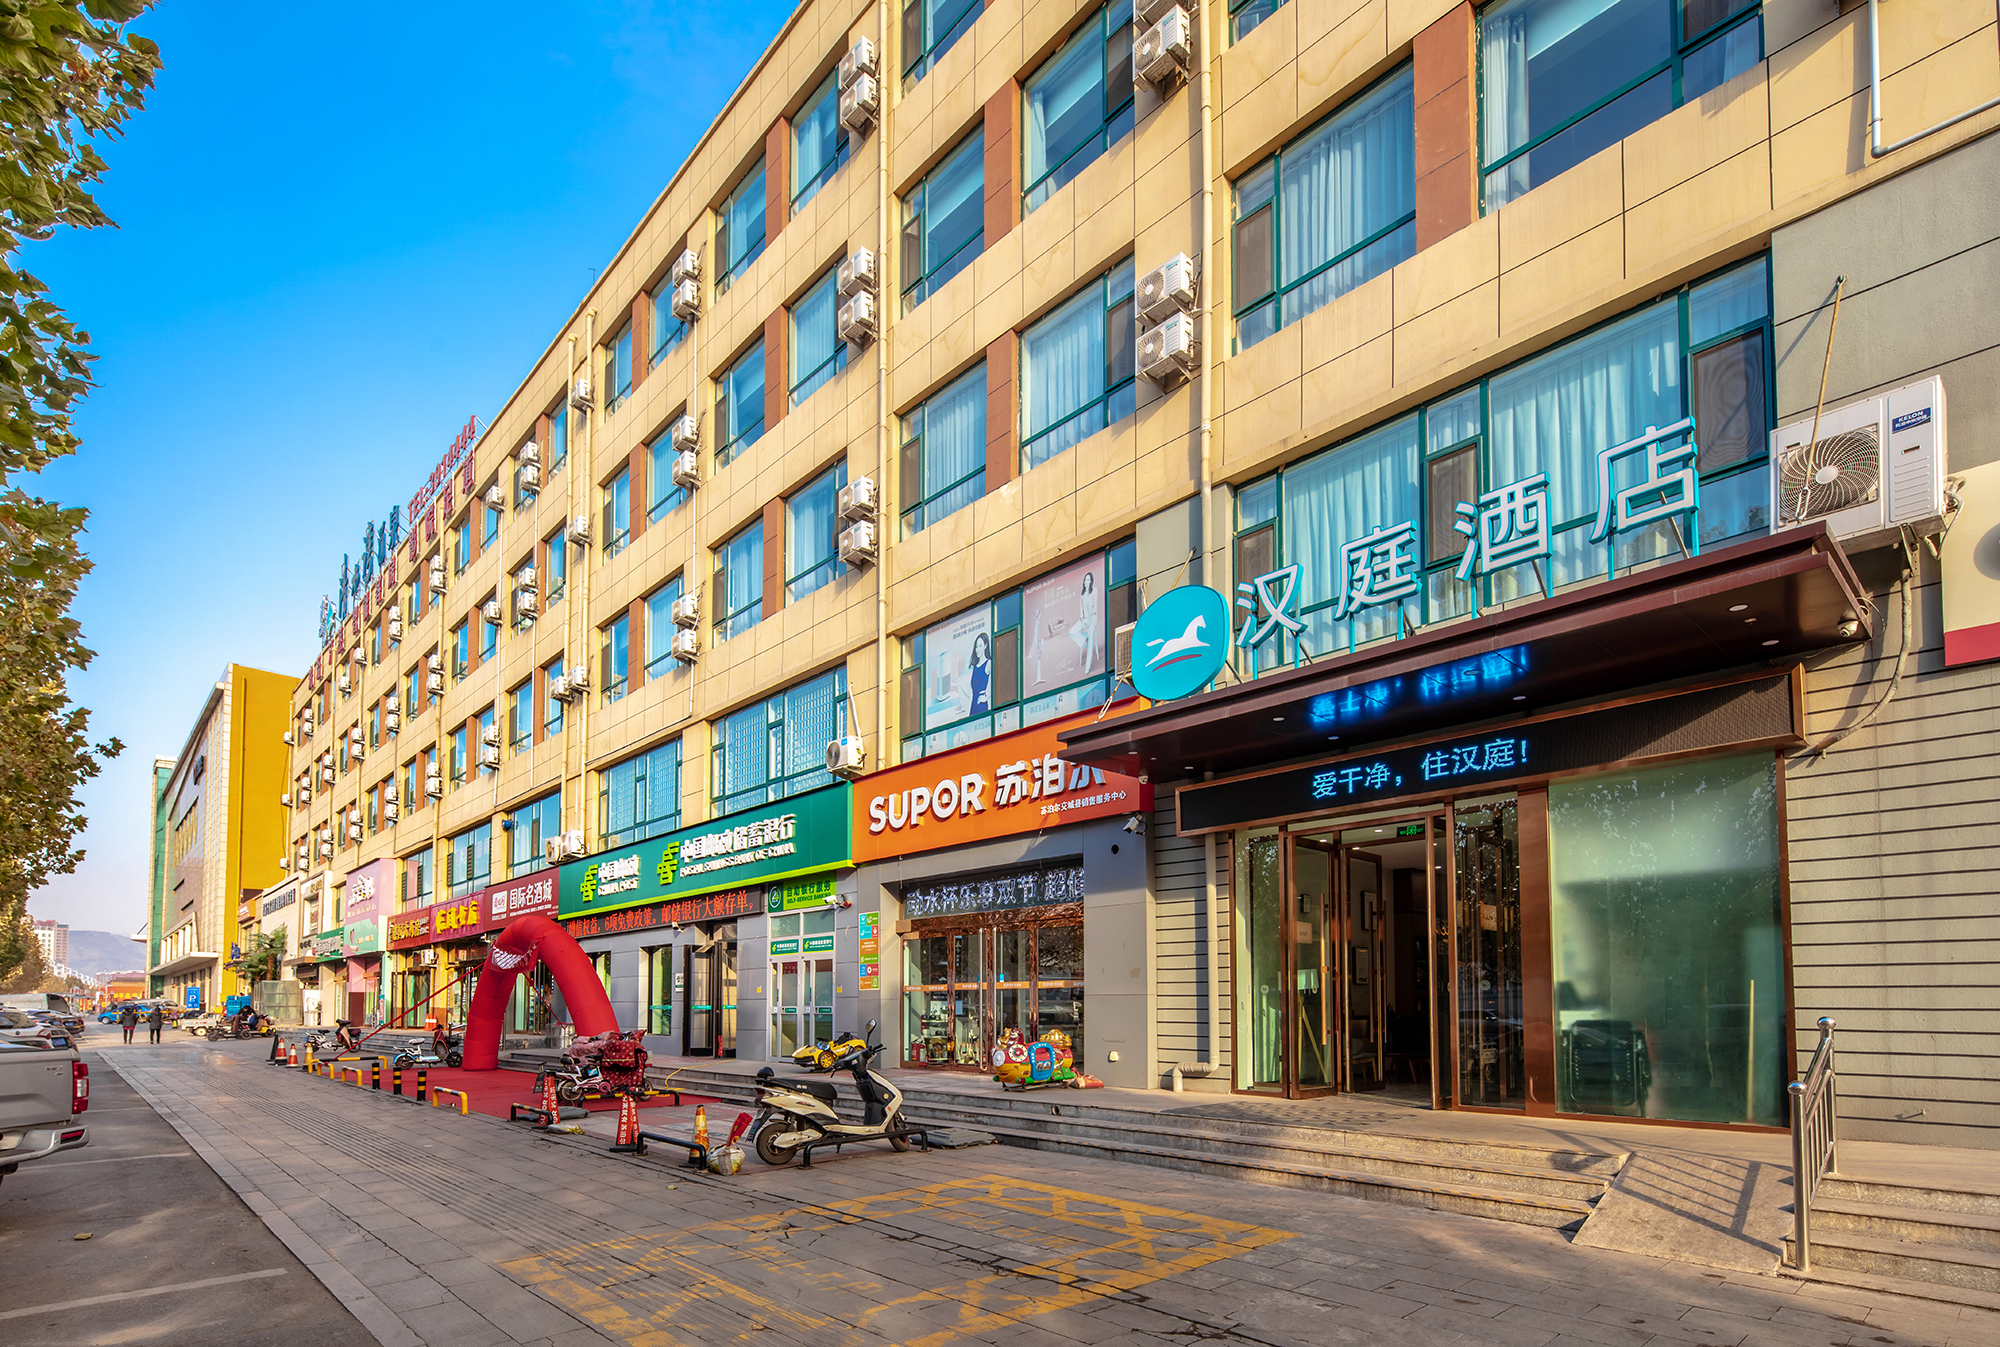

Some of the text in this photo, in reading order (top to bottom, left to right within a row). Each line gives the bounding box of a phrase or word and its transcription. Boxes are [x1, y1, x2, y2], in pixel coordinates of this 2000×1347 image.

[1898, 410, 1924, 422] KELON
[1235, 415, 1700, 649] 汉庭酒店
[869, 772, 986, 833] SUPOR
[680, 813, 797, 864] 中国邮政储蓄银行
[597, 854, 640, 883] 中国邮政
[509, 878, 553, 910] 国际名酒城
[786, 880, 832, 898] 自助银行服务
[189, 994, 197, 1002] P
